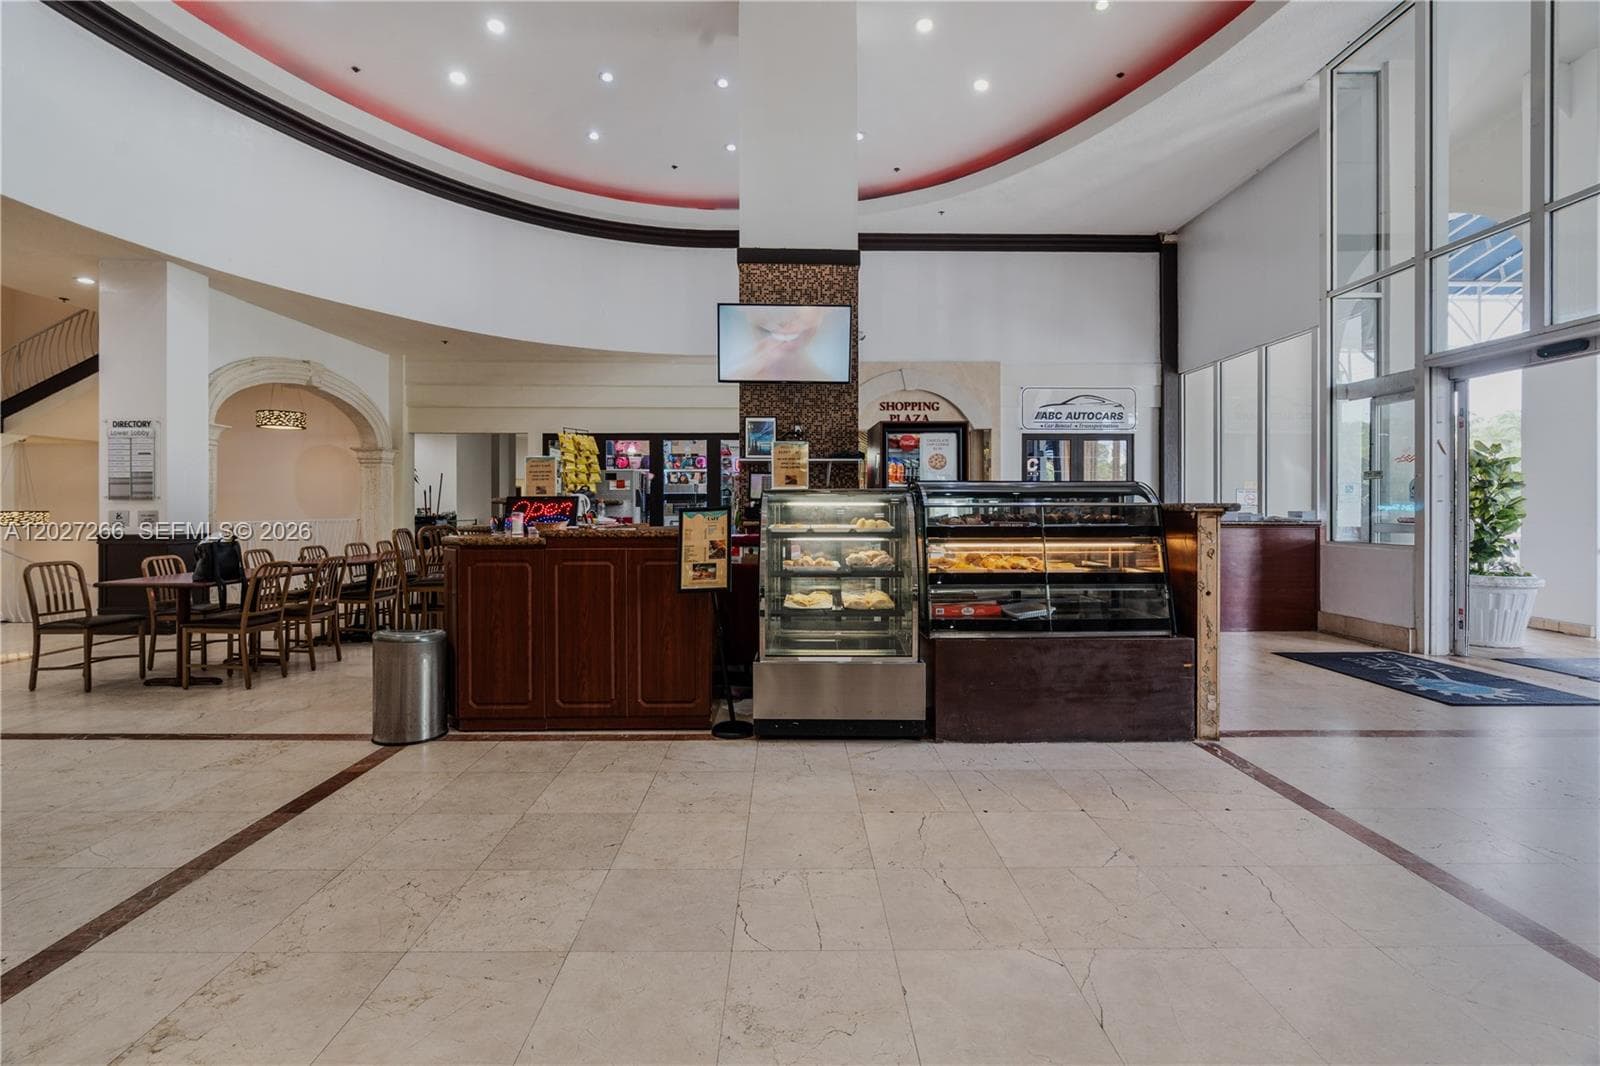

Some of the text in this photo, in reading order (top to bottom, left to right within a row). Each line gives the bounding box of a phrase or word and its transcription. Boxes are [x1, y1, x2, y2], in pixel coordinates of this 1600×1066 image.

[879, 401, 940, 412] SHOPPING
[889, 414, 930, 422] PLAZA
[1065, 411, 1124, 421] AUTOCARS
[112, 420, 152, 428] DIRECTORY
